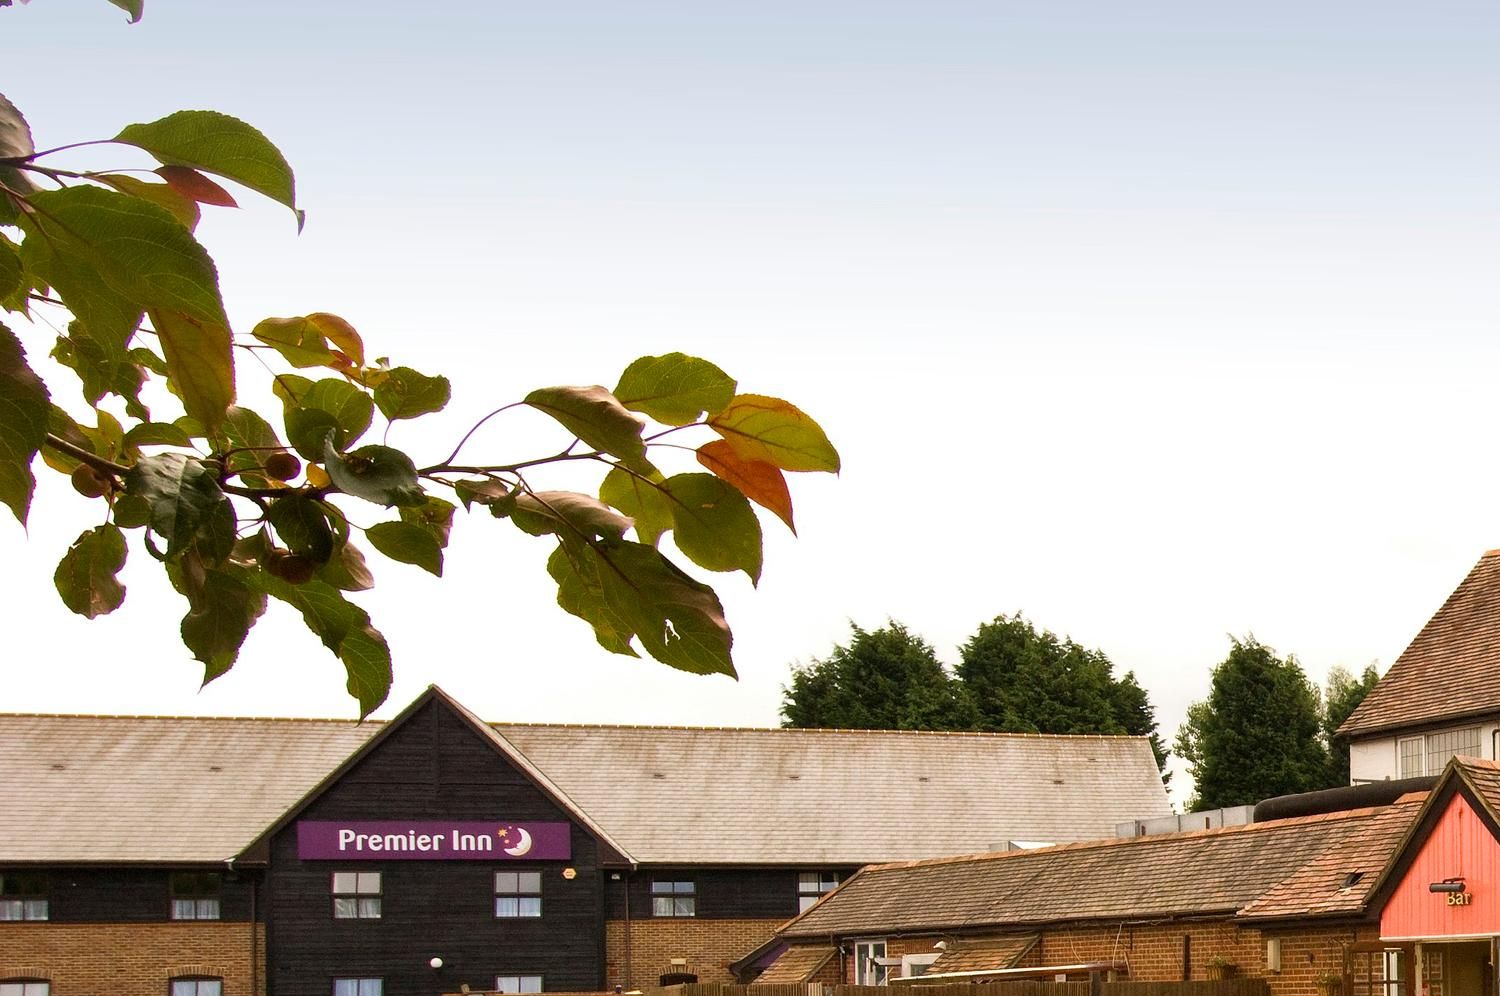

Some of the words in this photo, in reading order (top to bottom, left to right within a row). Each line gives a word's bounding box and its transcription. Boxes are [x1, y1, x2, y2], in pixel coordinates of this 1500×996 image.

[338, 829, 445, 851] Premier
[452, 829, 493, 851] Inn
[1447, 891, 1472, 906] Bar
